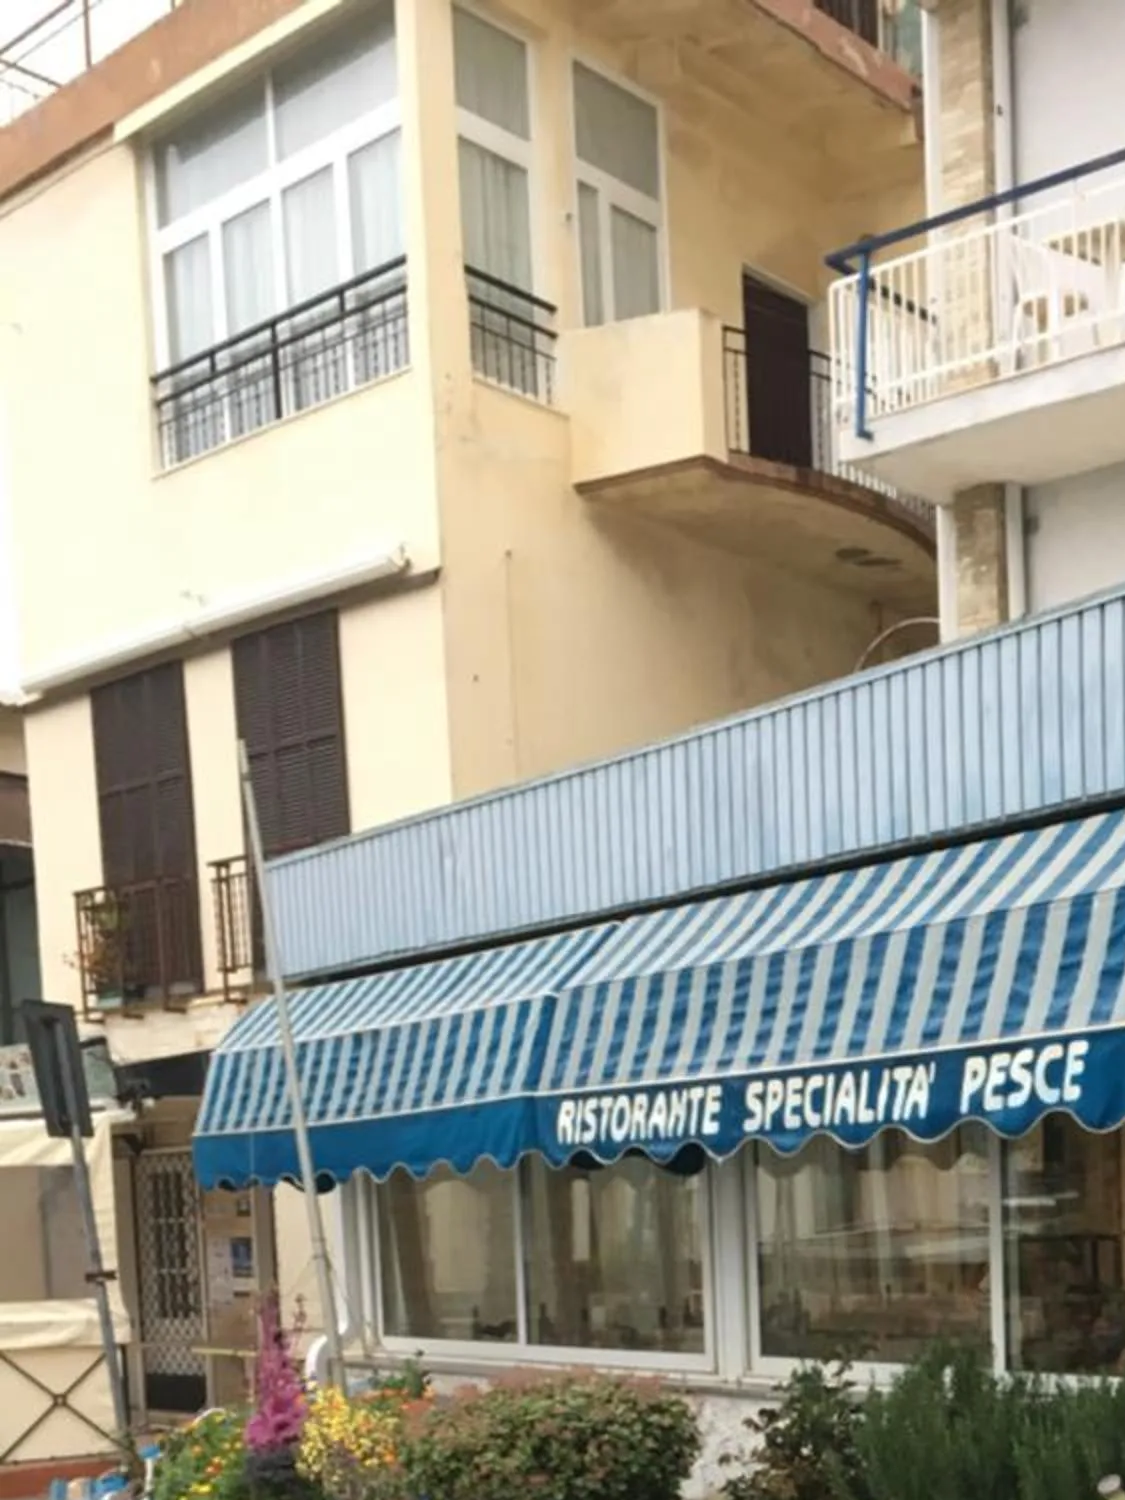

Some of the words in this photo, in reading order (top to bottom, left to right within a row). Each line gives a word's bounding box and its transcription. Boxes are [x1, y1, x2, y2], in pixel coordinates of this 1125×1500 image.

[556, 1085, 723, 1144] RISTORANTE
[742, 1062, 936, 1133] SPECIALITA'
[960, 1039, 1090, 1113] PESCE
